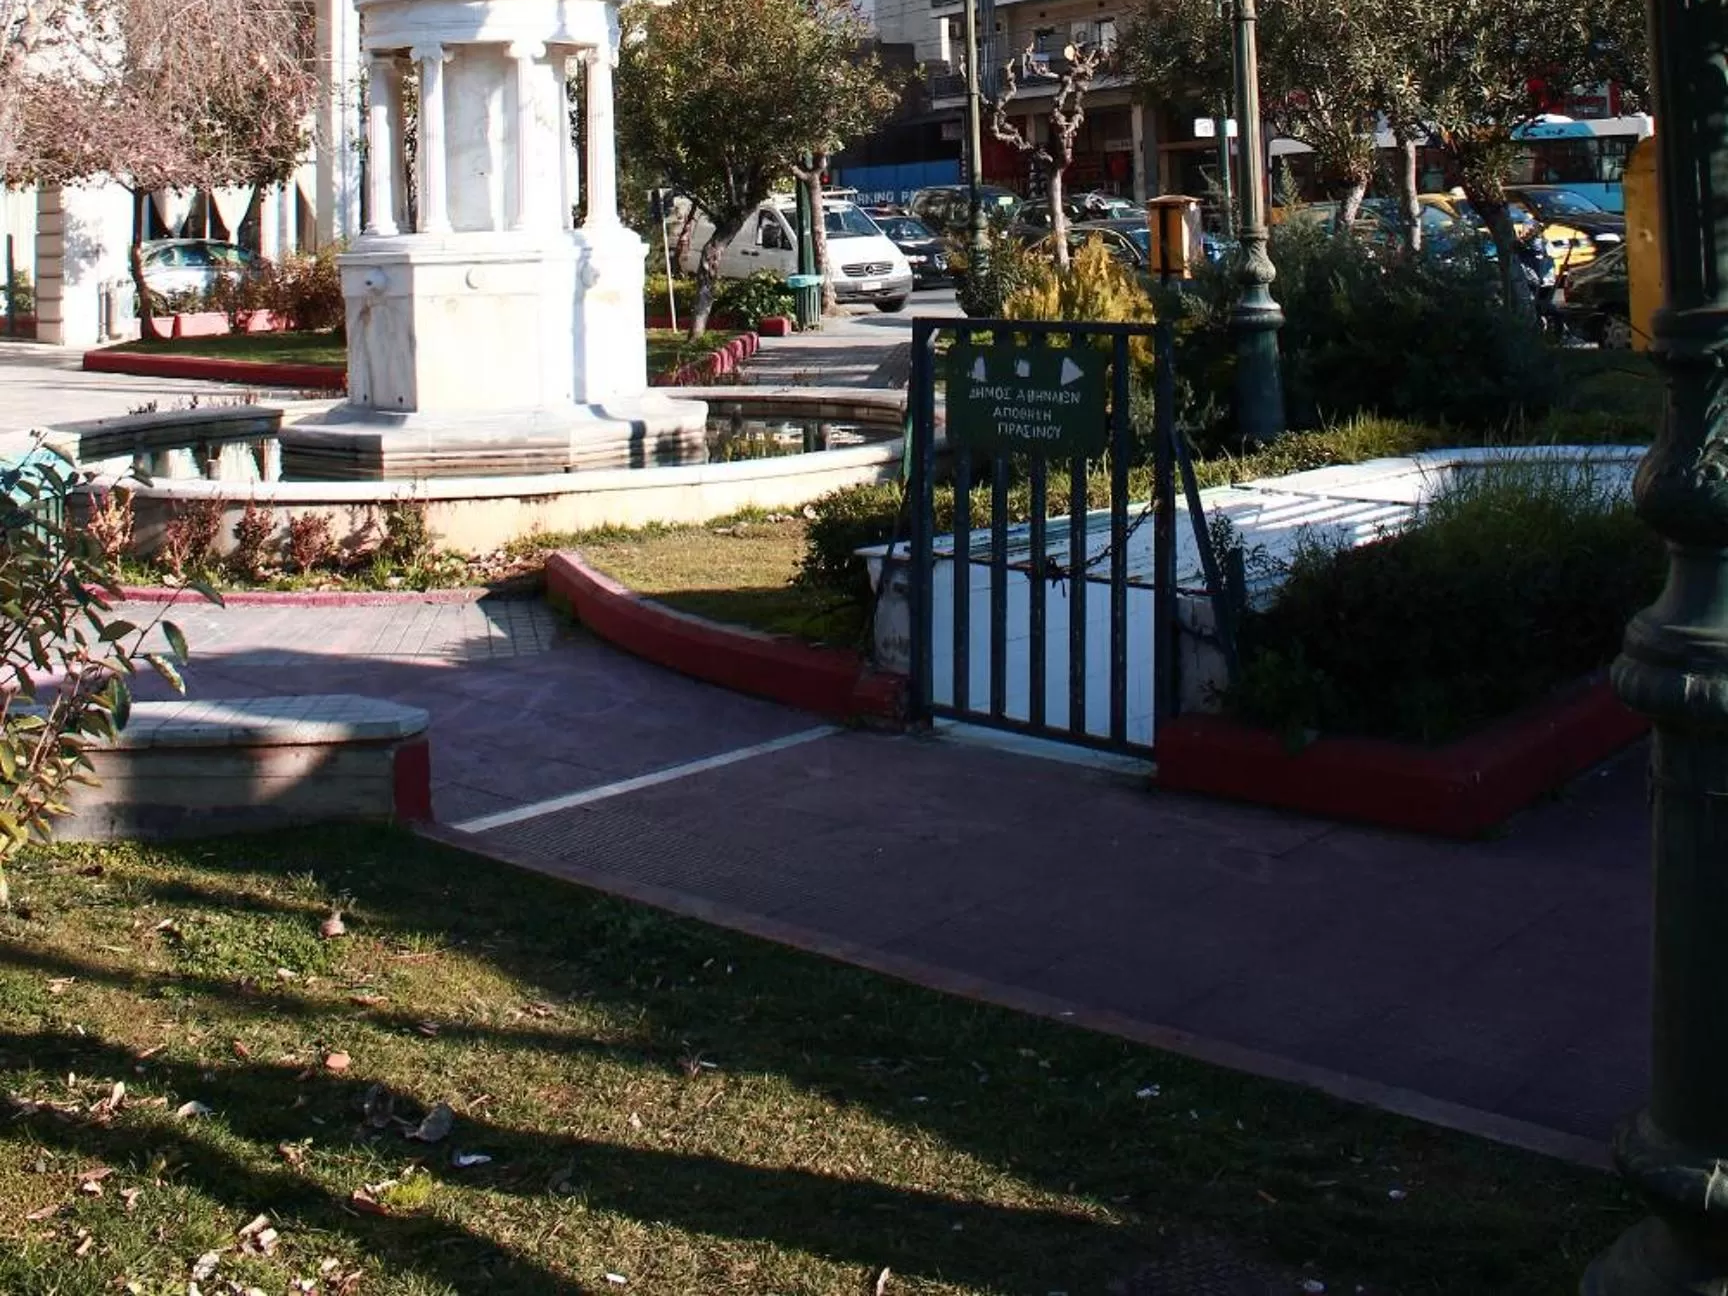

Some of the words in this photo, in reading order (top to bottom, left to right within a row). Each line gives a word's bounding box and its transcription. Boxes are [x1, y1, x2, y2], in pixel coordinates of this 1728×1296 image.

[968, 386, 1013, 401] ΔΗΜΟΣ
[992, 406, 1053, 422] ΑΠΟΘΗΚΗ
[997, 422, 1063, 441] ΠΡΑΣΙΝΟΥ
